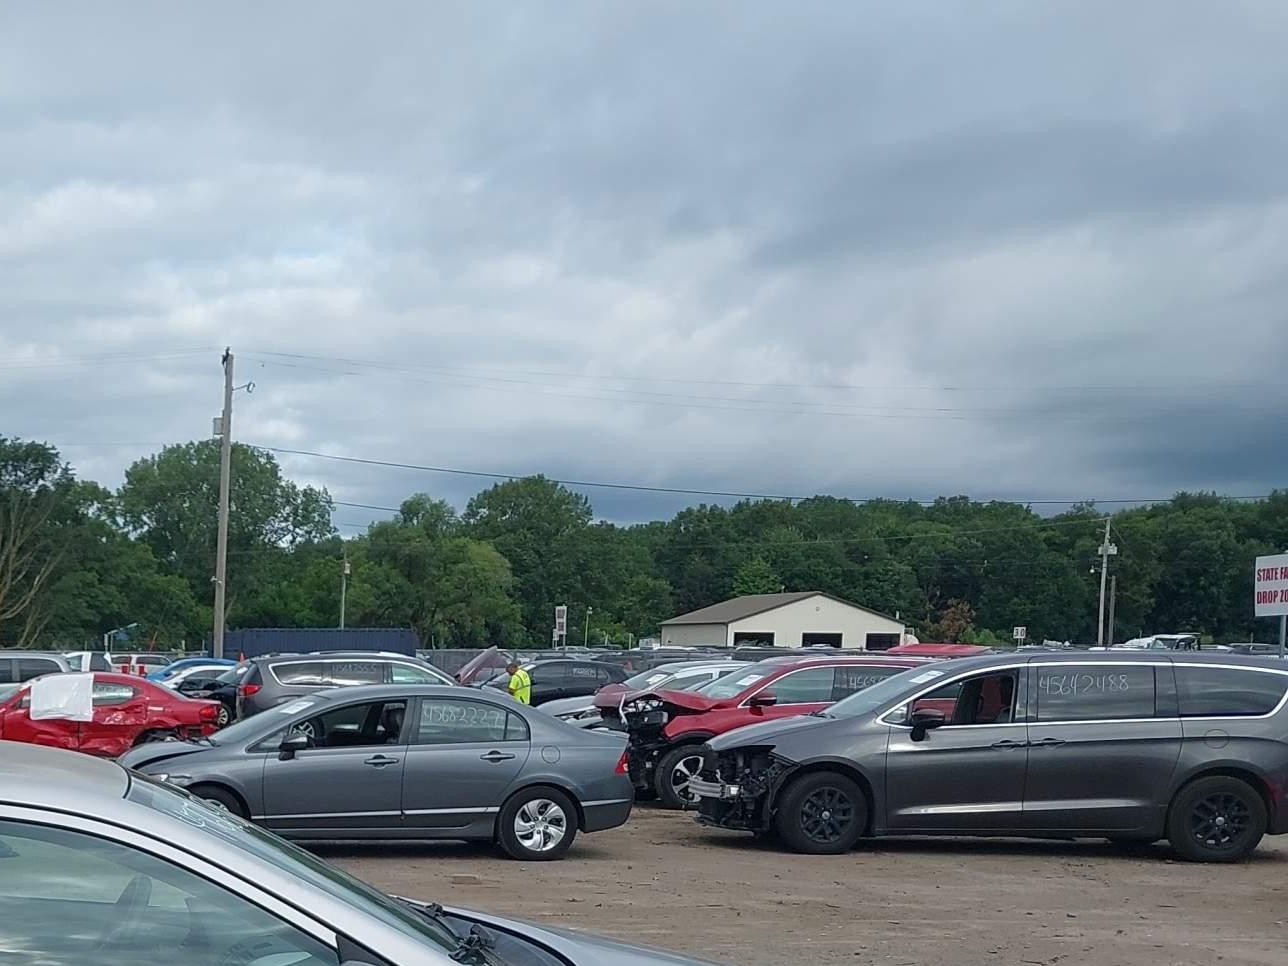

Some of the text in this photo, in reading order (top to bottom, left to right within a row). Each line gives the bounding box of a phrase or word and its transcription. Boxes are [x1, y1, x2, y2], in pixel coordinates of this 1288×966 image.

[1257, 567, 1279, 582] STATE
[1257, 590, 1279, 604] DROP
[1039, 672, 1129, 696] 45642488
